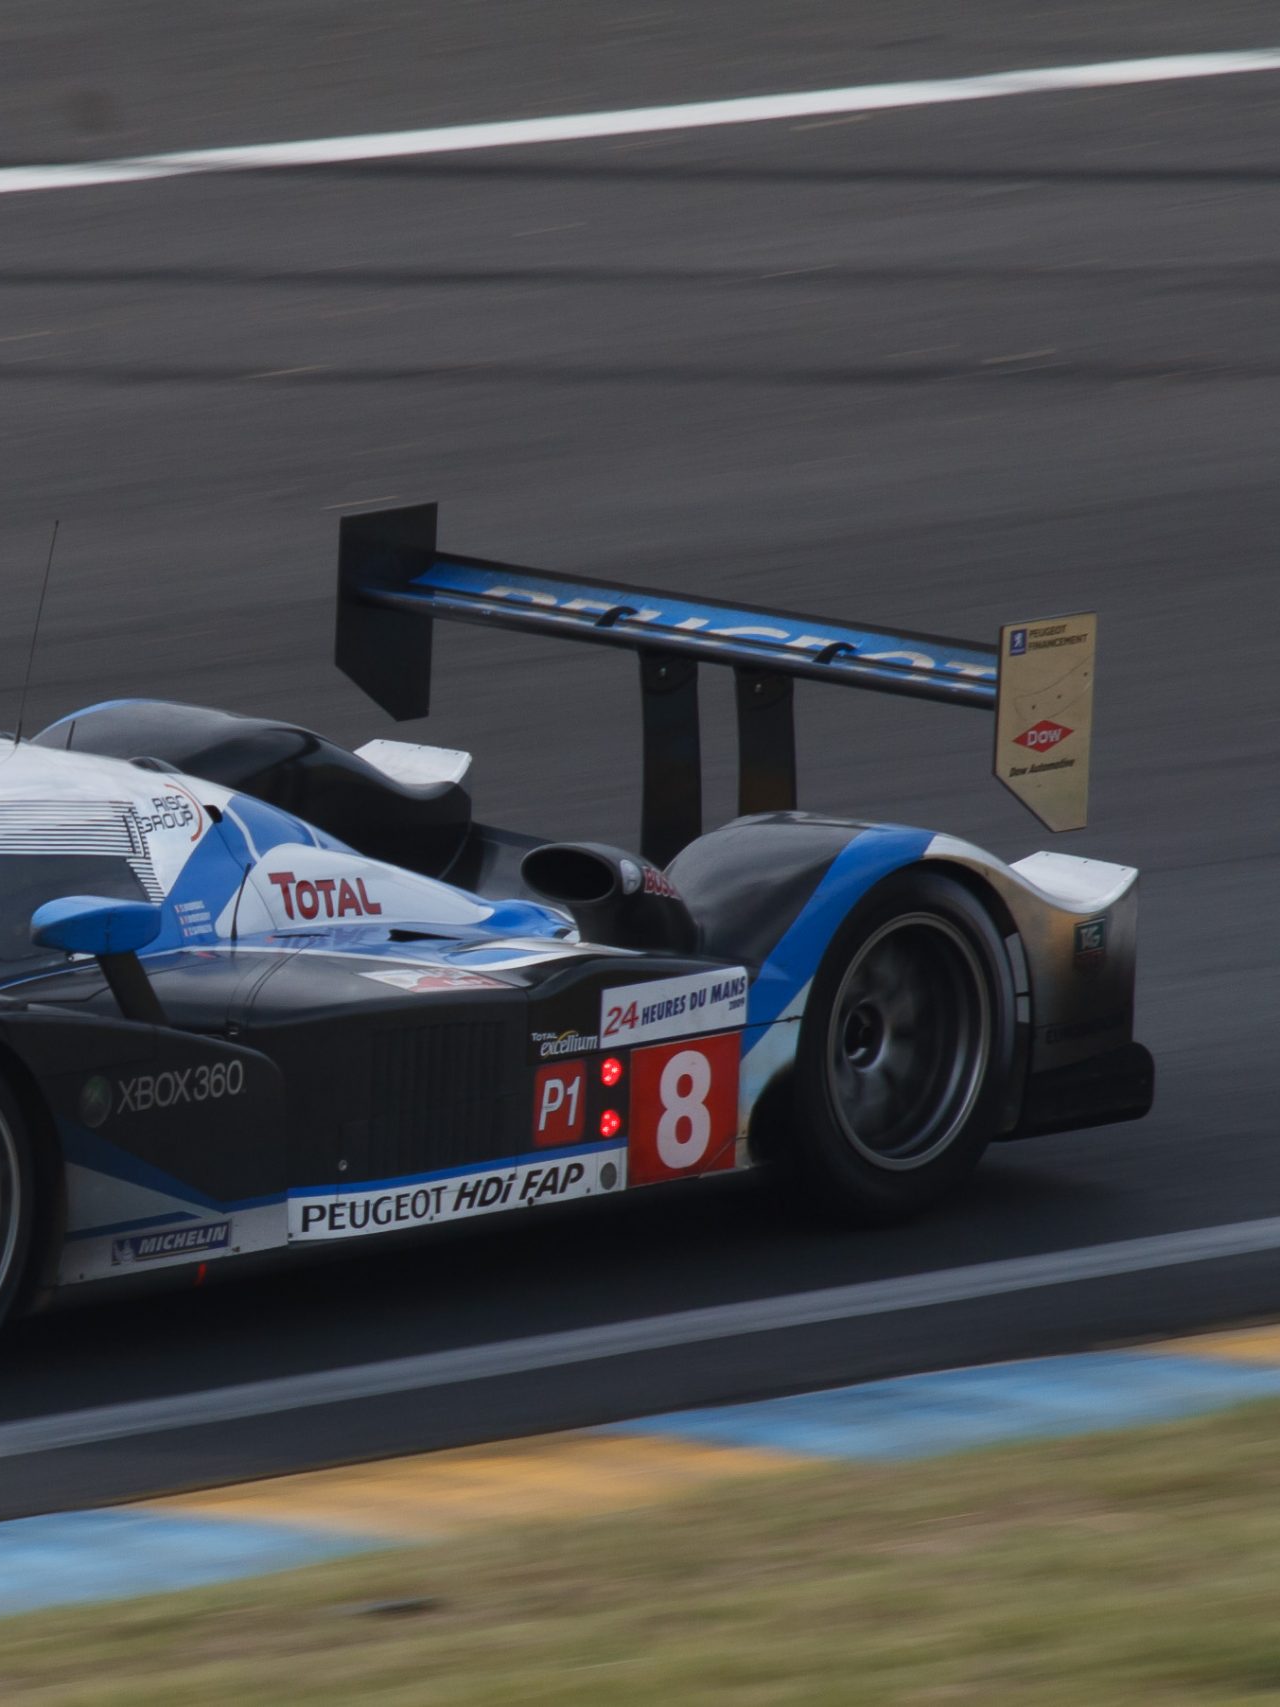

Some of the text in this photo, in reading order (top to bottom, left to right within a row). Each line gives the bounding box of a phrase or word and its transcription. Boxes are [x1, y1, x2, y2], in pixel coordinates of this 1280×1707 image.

[1028, 624, 1068, 639] PEUGEOT
[1028, 633, 1089, 651] FINANCEMENT
[151, 795, 190, 813] RISC
[141, 810, 194, 834] GROUP
[267, 871, 382, 920] TOTAL
[603, 975, 746, 1038] 24 HEURES DU MANS
[531, 1032, 558, 1042] TOTAL
[540, 1033, 598, 1057] excellium
[538, 1076, 581, 1131] P1
[656, 1050, 712, 1169] 8
[301, 1162, 585, 1233] PEUGEOT HDi FAP
[138, 1224, 229, 1256] MICHELIN
